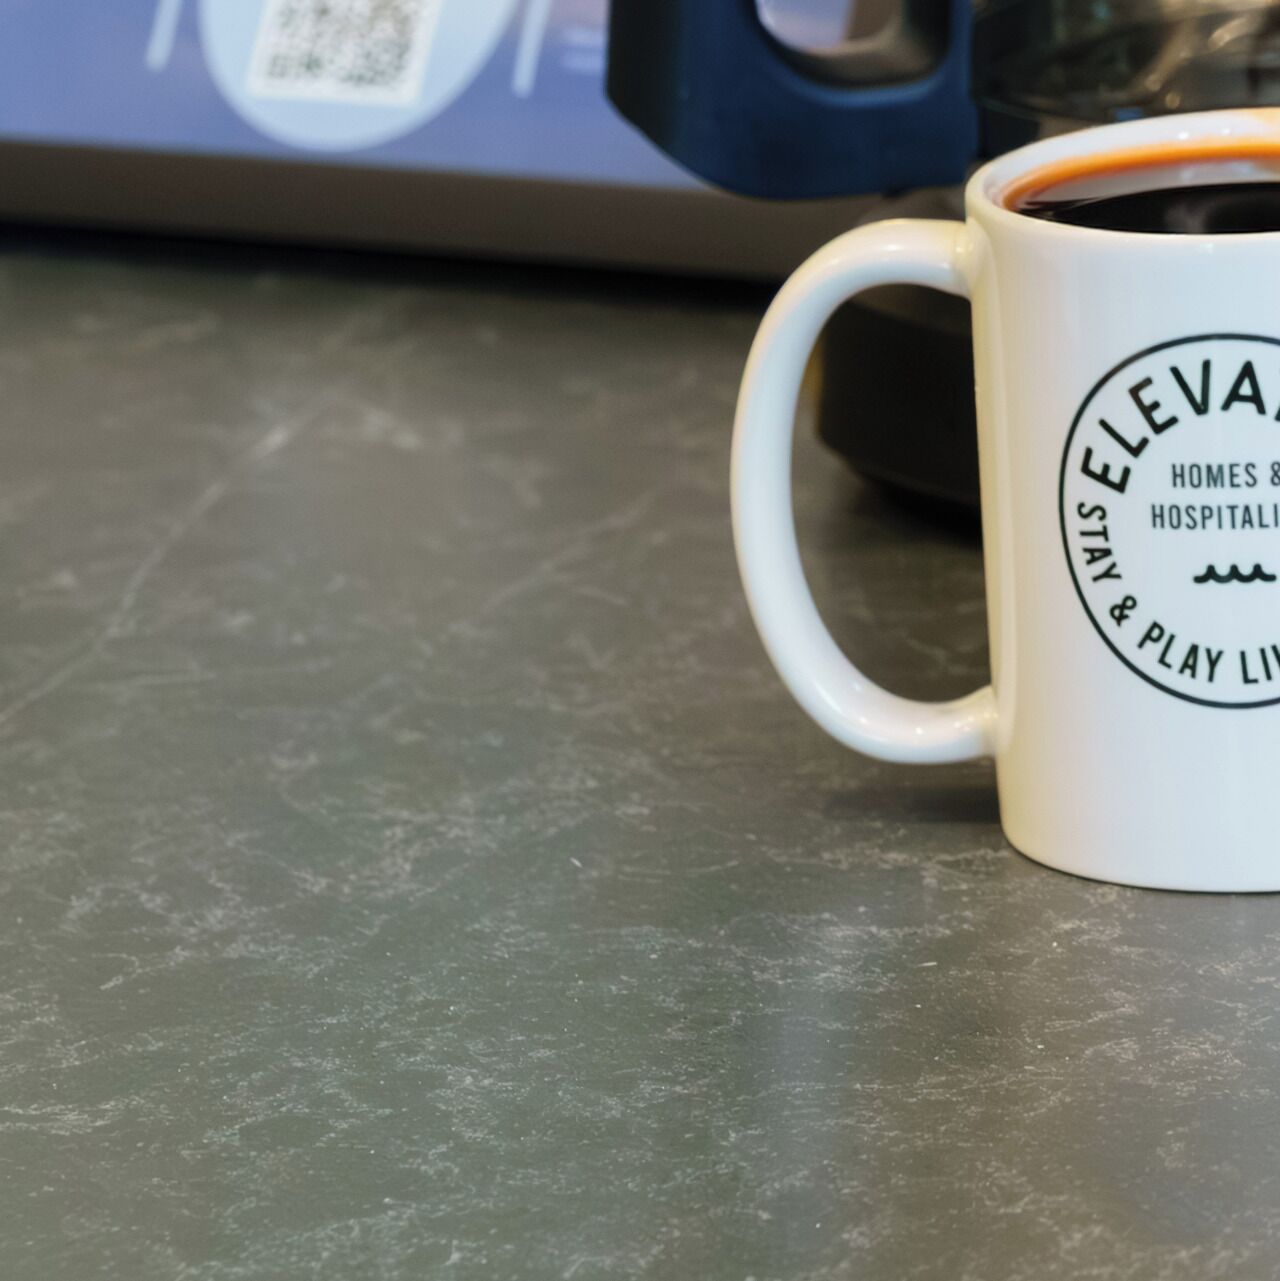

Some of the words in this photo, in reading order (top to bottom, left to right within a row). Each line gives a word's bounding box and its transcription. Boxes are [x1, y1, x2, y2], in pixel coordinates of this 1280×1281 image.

[1171, 463, 1258, 489] HOMES
[1077, 502, 1122, 583] STAY
[1109, 595, 1138, 627] &
[1137, 621, 1224, 684] PLAY
